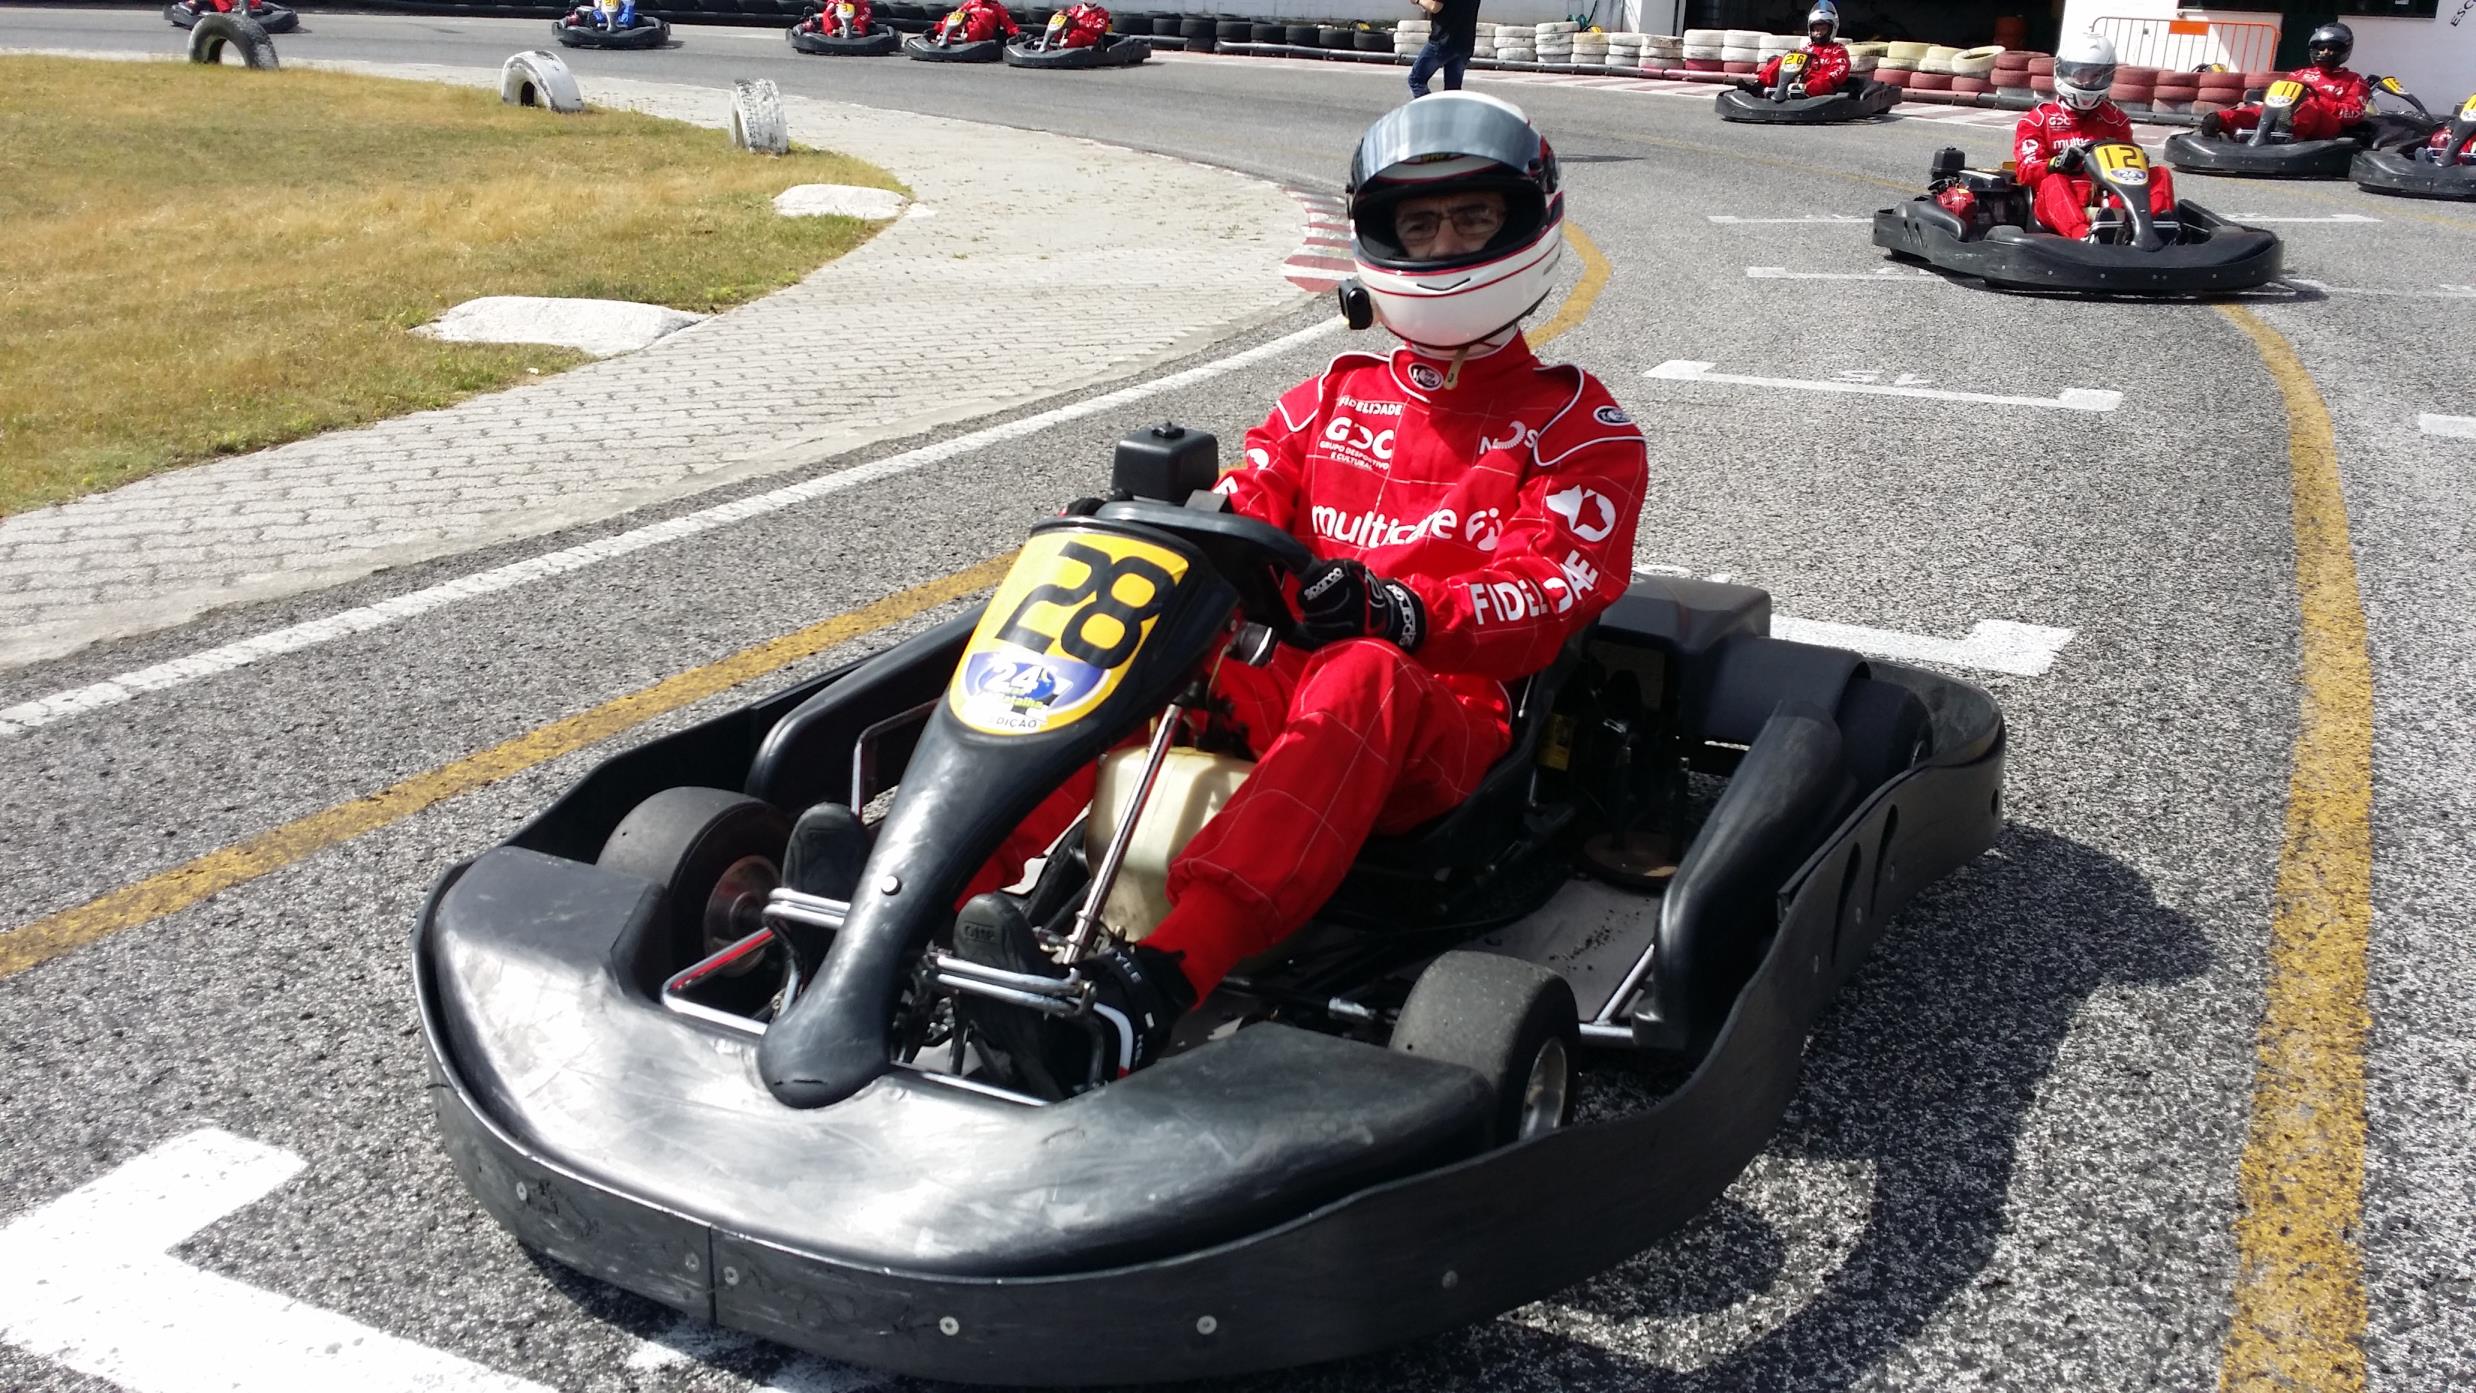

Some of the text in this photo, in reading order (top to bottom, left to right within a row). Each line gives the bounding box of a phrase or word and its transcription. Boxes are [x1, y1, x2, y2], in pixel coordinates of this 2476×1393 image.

[2450, 0, 2476, 27] ESC
[1784, 54, 1805, 65] 26
[2281, 82, 2298, 98] 11
[2103, 146, 2142, 169] 12
[994, 540, 1177, 670] 28
